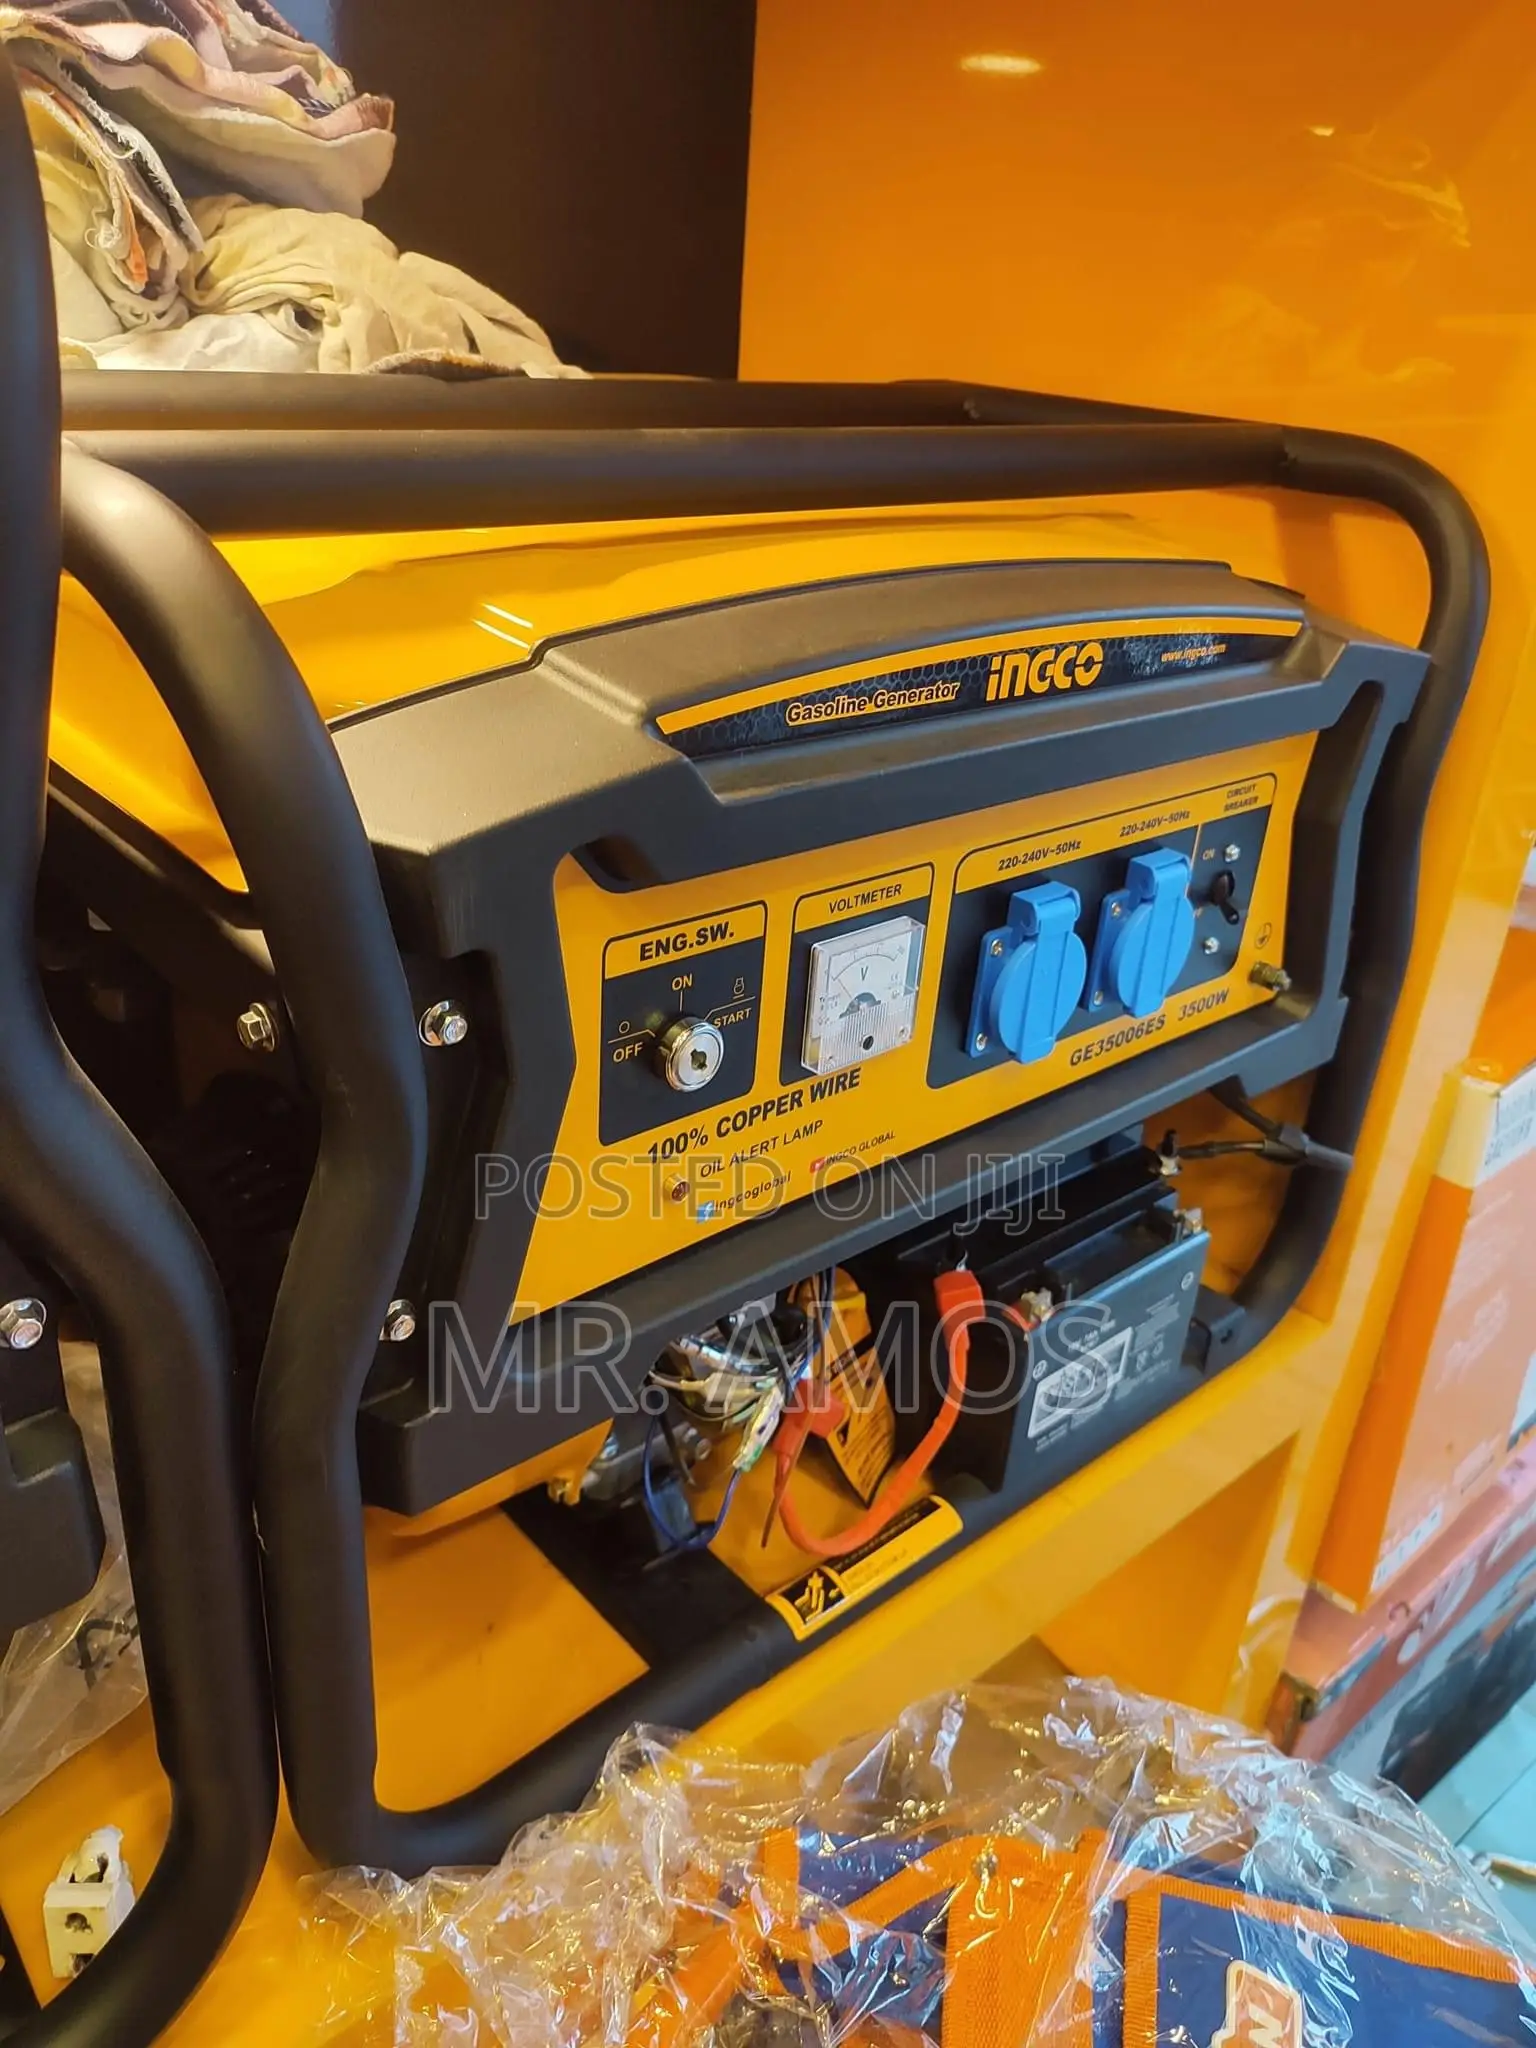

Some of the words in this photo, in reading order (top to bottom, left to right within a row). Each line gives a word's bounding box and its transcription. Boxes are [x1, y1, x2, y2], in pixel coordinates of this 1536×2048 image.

[1161, 643, 1227, 662] www.ingco.com
[786, 697, 867, 724] Gasoline
[873, 682, 960, 709] Generator
[1224, 796, 1259, 812] BREAKER
[1226, 784, 1256, 799] CIRCUIT
[1202, 848, 1215, 860] ON
[828, 883, 903, 914] VOLTMETER
[640, 921, 735, 961] ENG.SW.
[672, 973, 693, 990] ON
[860, 966, 869, 981] V
[714, 1008, 752, 1028] START
[1178, 989, 1230, 1021] 3500W
[612, 1042, 643, 1063] OFF
[1070, 1014, 1166, 1066] GE35006ES
[648, 1125, 709, 1164] 100%
[716, 1089, 804, 1138] COPPER
[810, 1068, 862, 1103] WIRE
[700, 1160, 725, 1178] OIL
[729, 1136, 780, 1167] ALERT
[783, 1119, 824, 1145] LAMP
[826, 1147, 857, 1166] INGCO
[858, 1131, 896, 1152] GLOBAL
[715, 1171, 792, 1212] ingcoglobal
